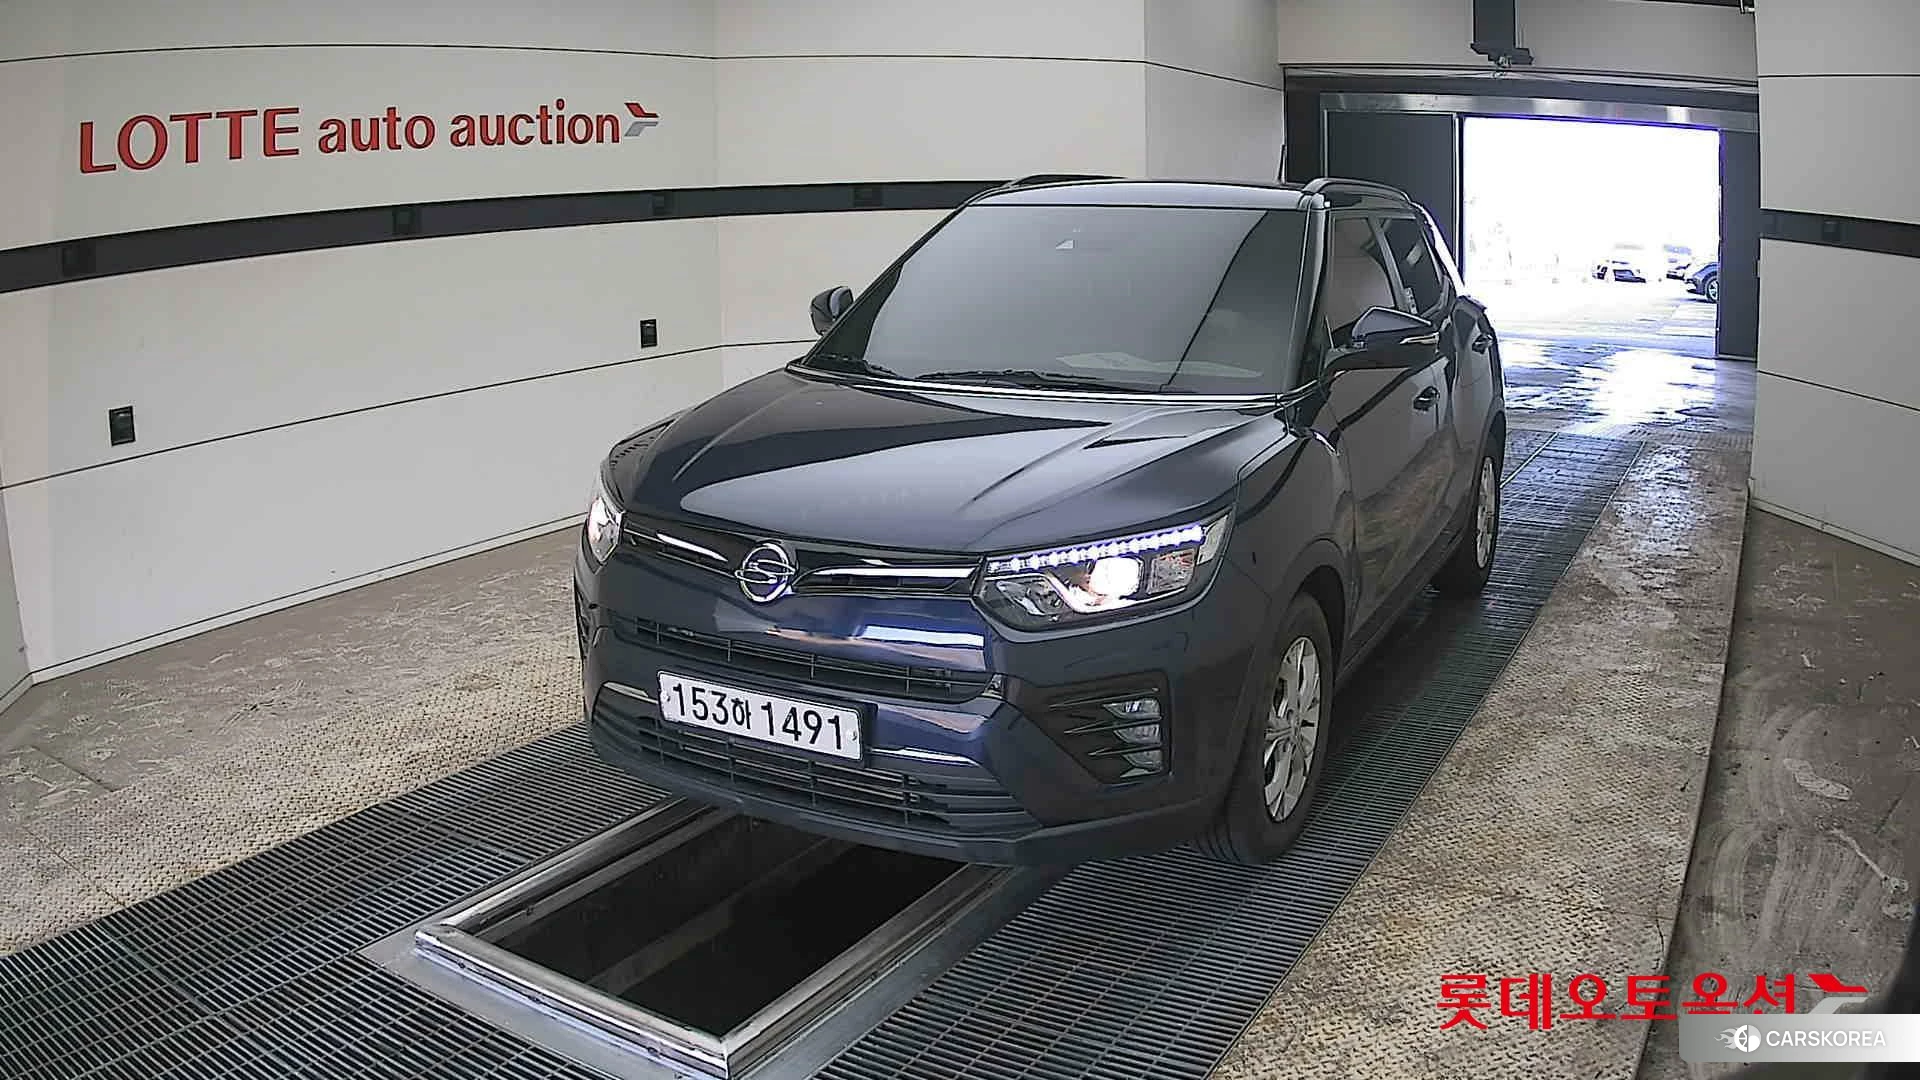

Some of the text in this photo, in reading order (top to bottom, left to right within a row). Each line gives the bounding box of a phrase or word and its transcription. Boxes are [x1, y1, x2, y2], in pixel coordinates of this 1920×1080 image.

[79, 98, 622, 174] LOTTE auto auction
[672, 683, 842, 750] 153하 1491
